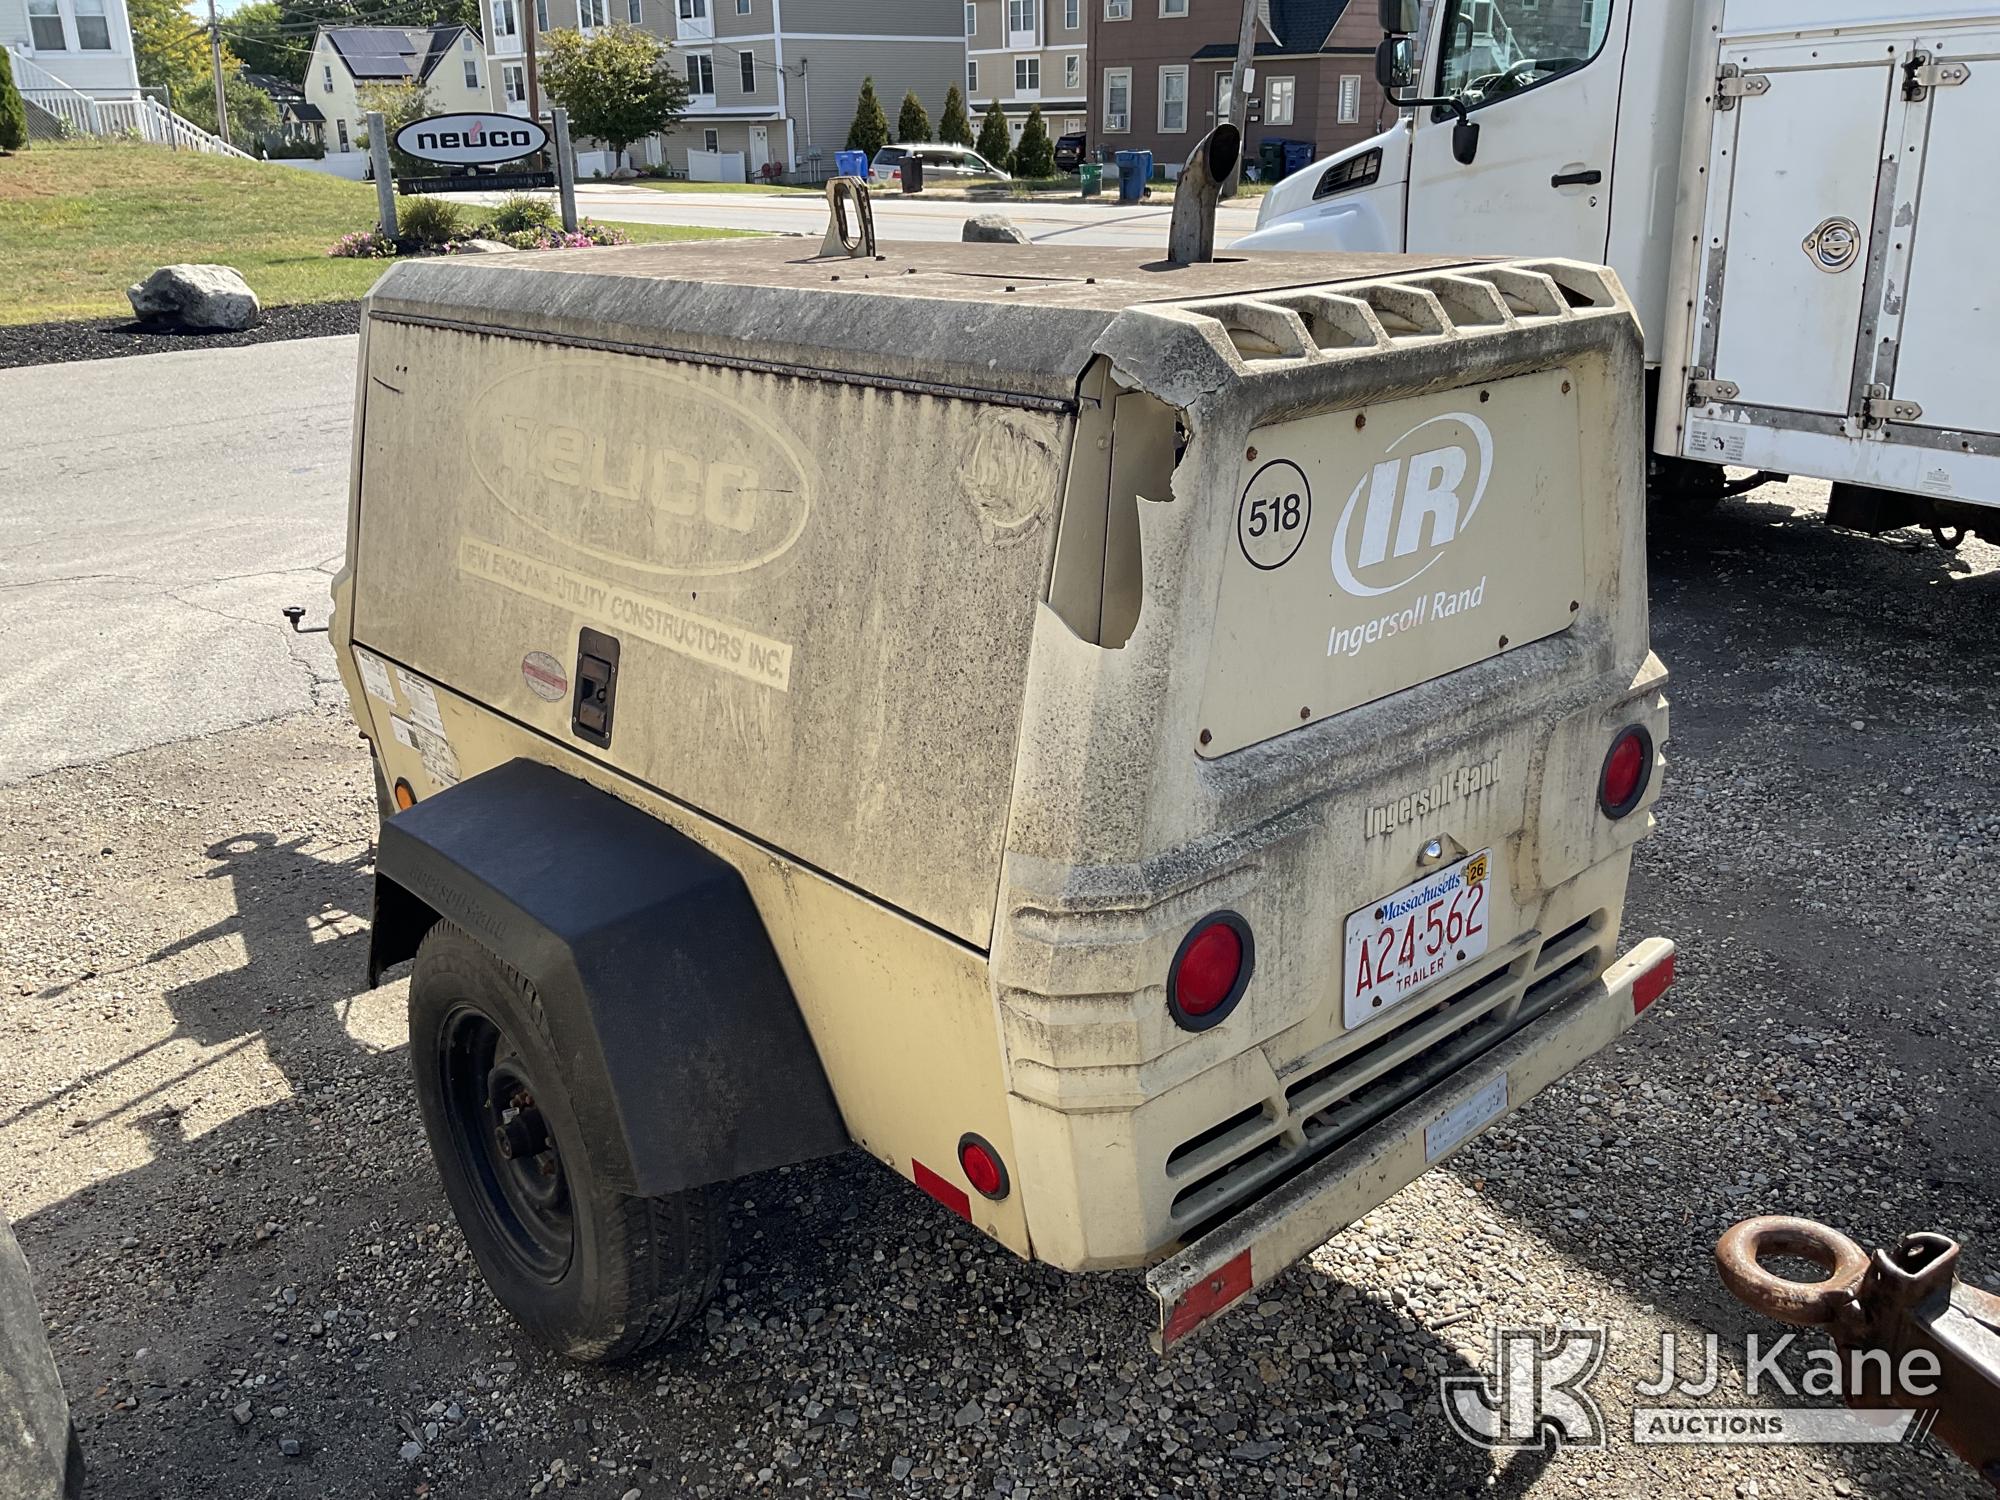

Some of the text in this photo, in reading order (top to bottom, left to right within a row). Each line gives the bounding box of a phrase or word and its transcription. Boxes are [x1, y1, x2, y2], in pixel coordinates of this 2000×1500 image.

[417, 130, 531, 149] neuco
[1248, 494, 1301, 537] 518
[1357, 446, 1467, 568] IR
[610, 596, 743, 663] CONSTRUCTORS
[749, 641, 785, 680] INC.
[1326, 576, 1487, 657] Ingersoll Rand
[1470, 863, 1484, 882] 26
[1381, 873, 1461, 924] Massachusetts
[1396, 956, 1444, 992] TRAILER
